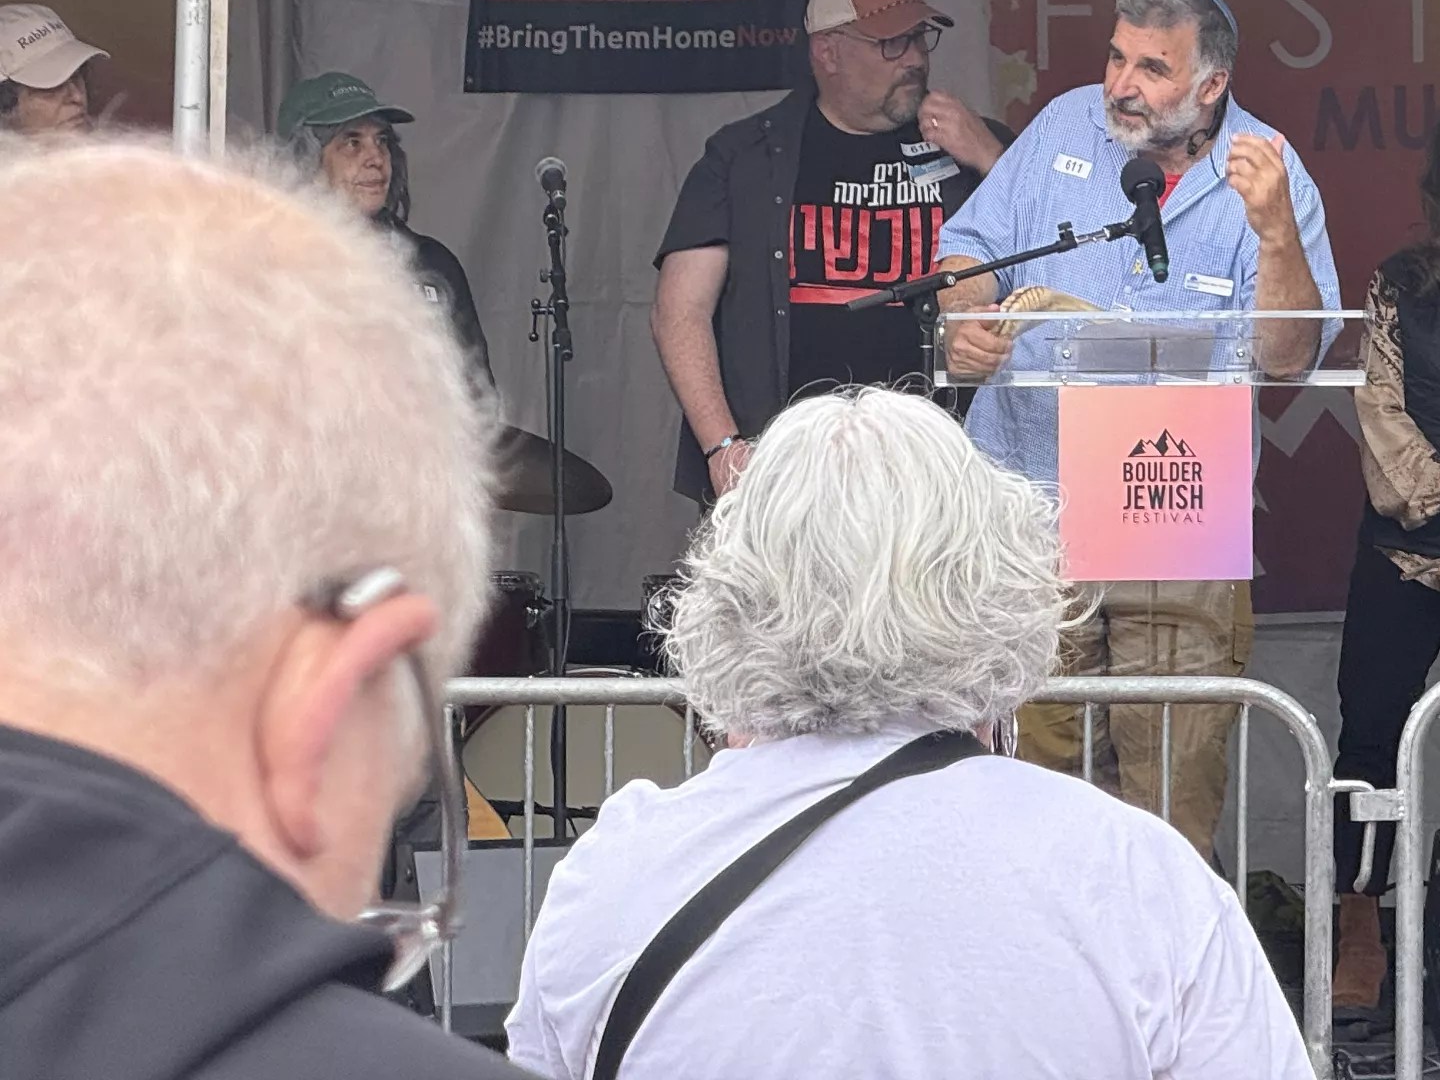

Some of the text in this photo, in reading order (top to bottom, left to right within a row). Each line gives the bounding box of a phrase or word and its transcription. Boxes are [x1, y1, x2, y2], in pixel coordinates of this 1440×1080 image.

[478, 23, 798, 55] #BringThemHomeNow
[911, 143, 931, 153] 611
[1065, 159, 1083, 174] 611
[833, 181, 893, 207] הביתה
[1123, 461, 1203, 482] BOULDER
[1123, 484, 1204, 510] JEWISH
[1123, 512, 1203, 523] FESTIVAL
